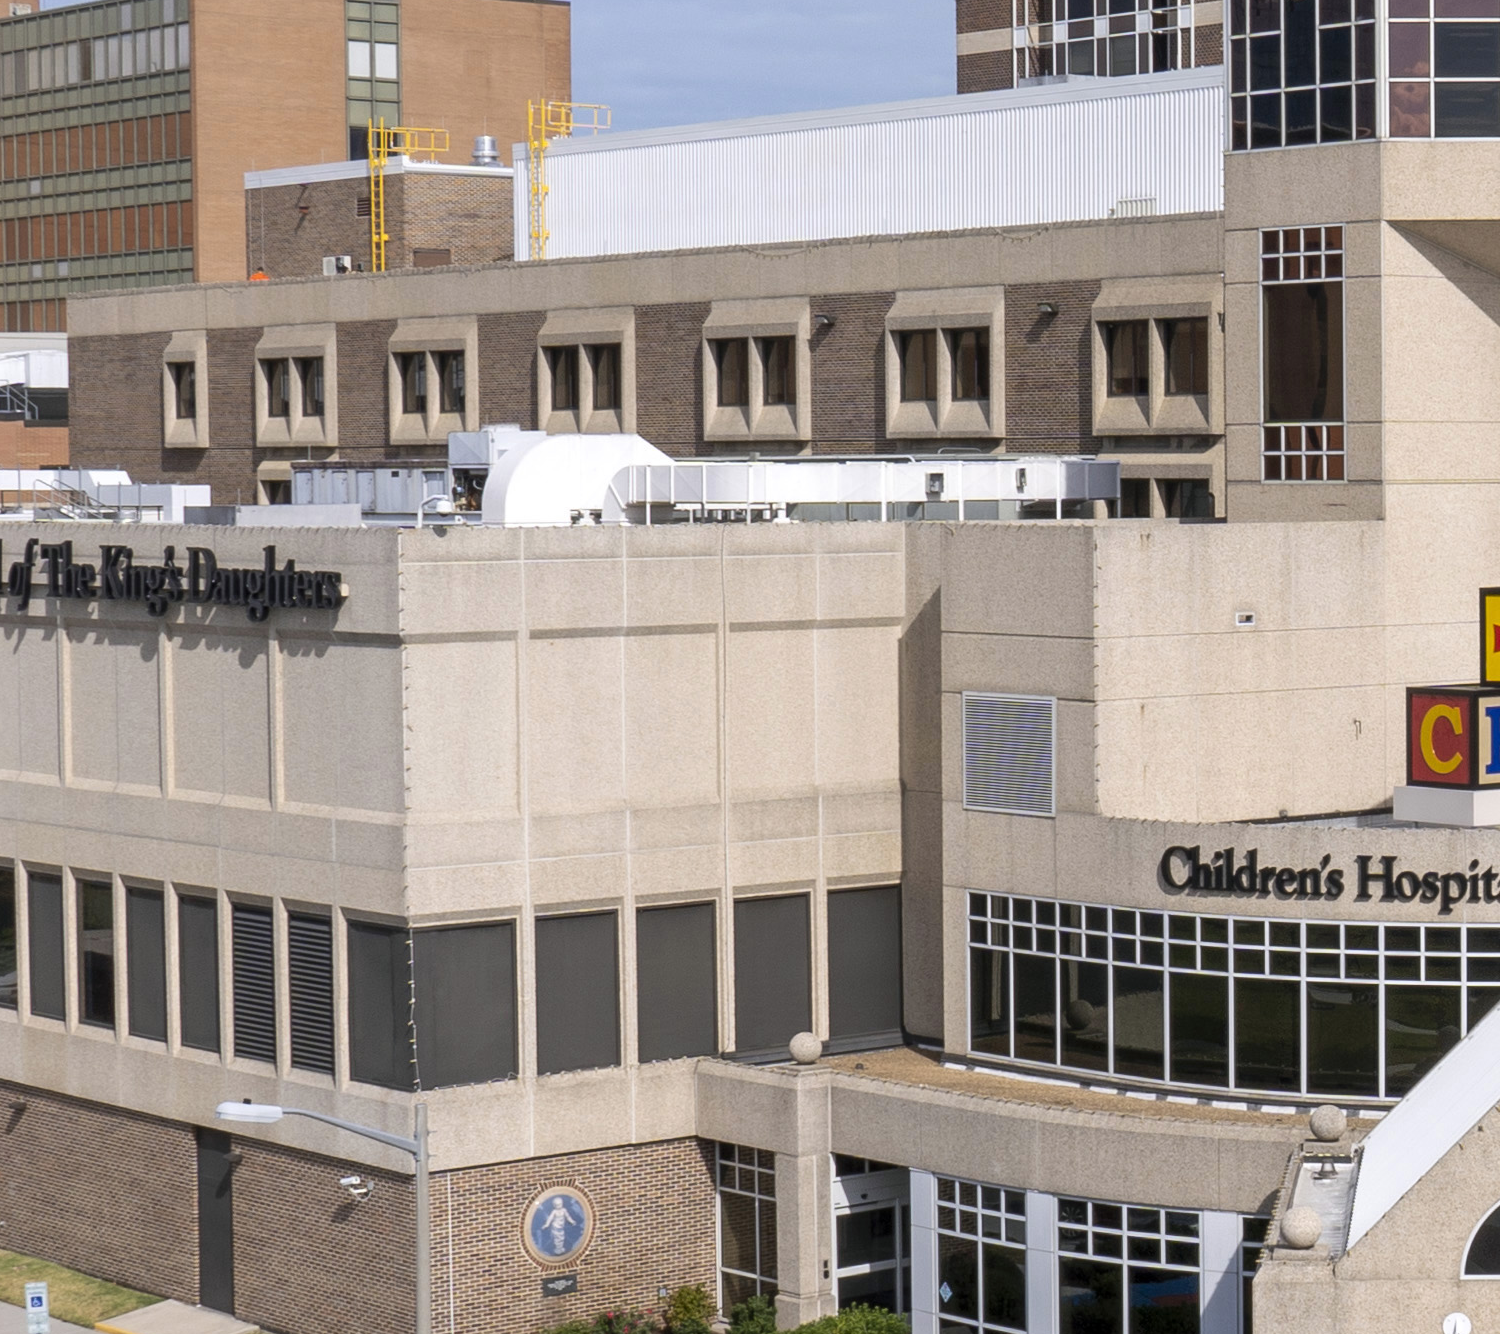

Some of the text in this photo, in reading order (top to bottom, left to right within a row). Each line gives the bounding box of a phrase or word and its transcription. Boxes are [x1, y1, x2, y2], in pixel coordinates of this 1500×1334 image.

[8, 538, 39, 610] of
[40, 540, 97, 598] The
[99, 545, 184, 616] King's
[186, 545, 342, 621] Daughters
[1160, 844, 1345, 899] Children's
